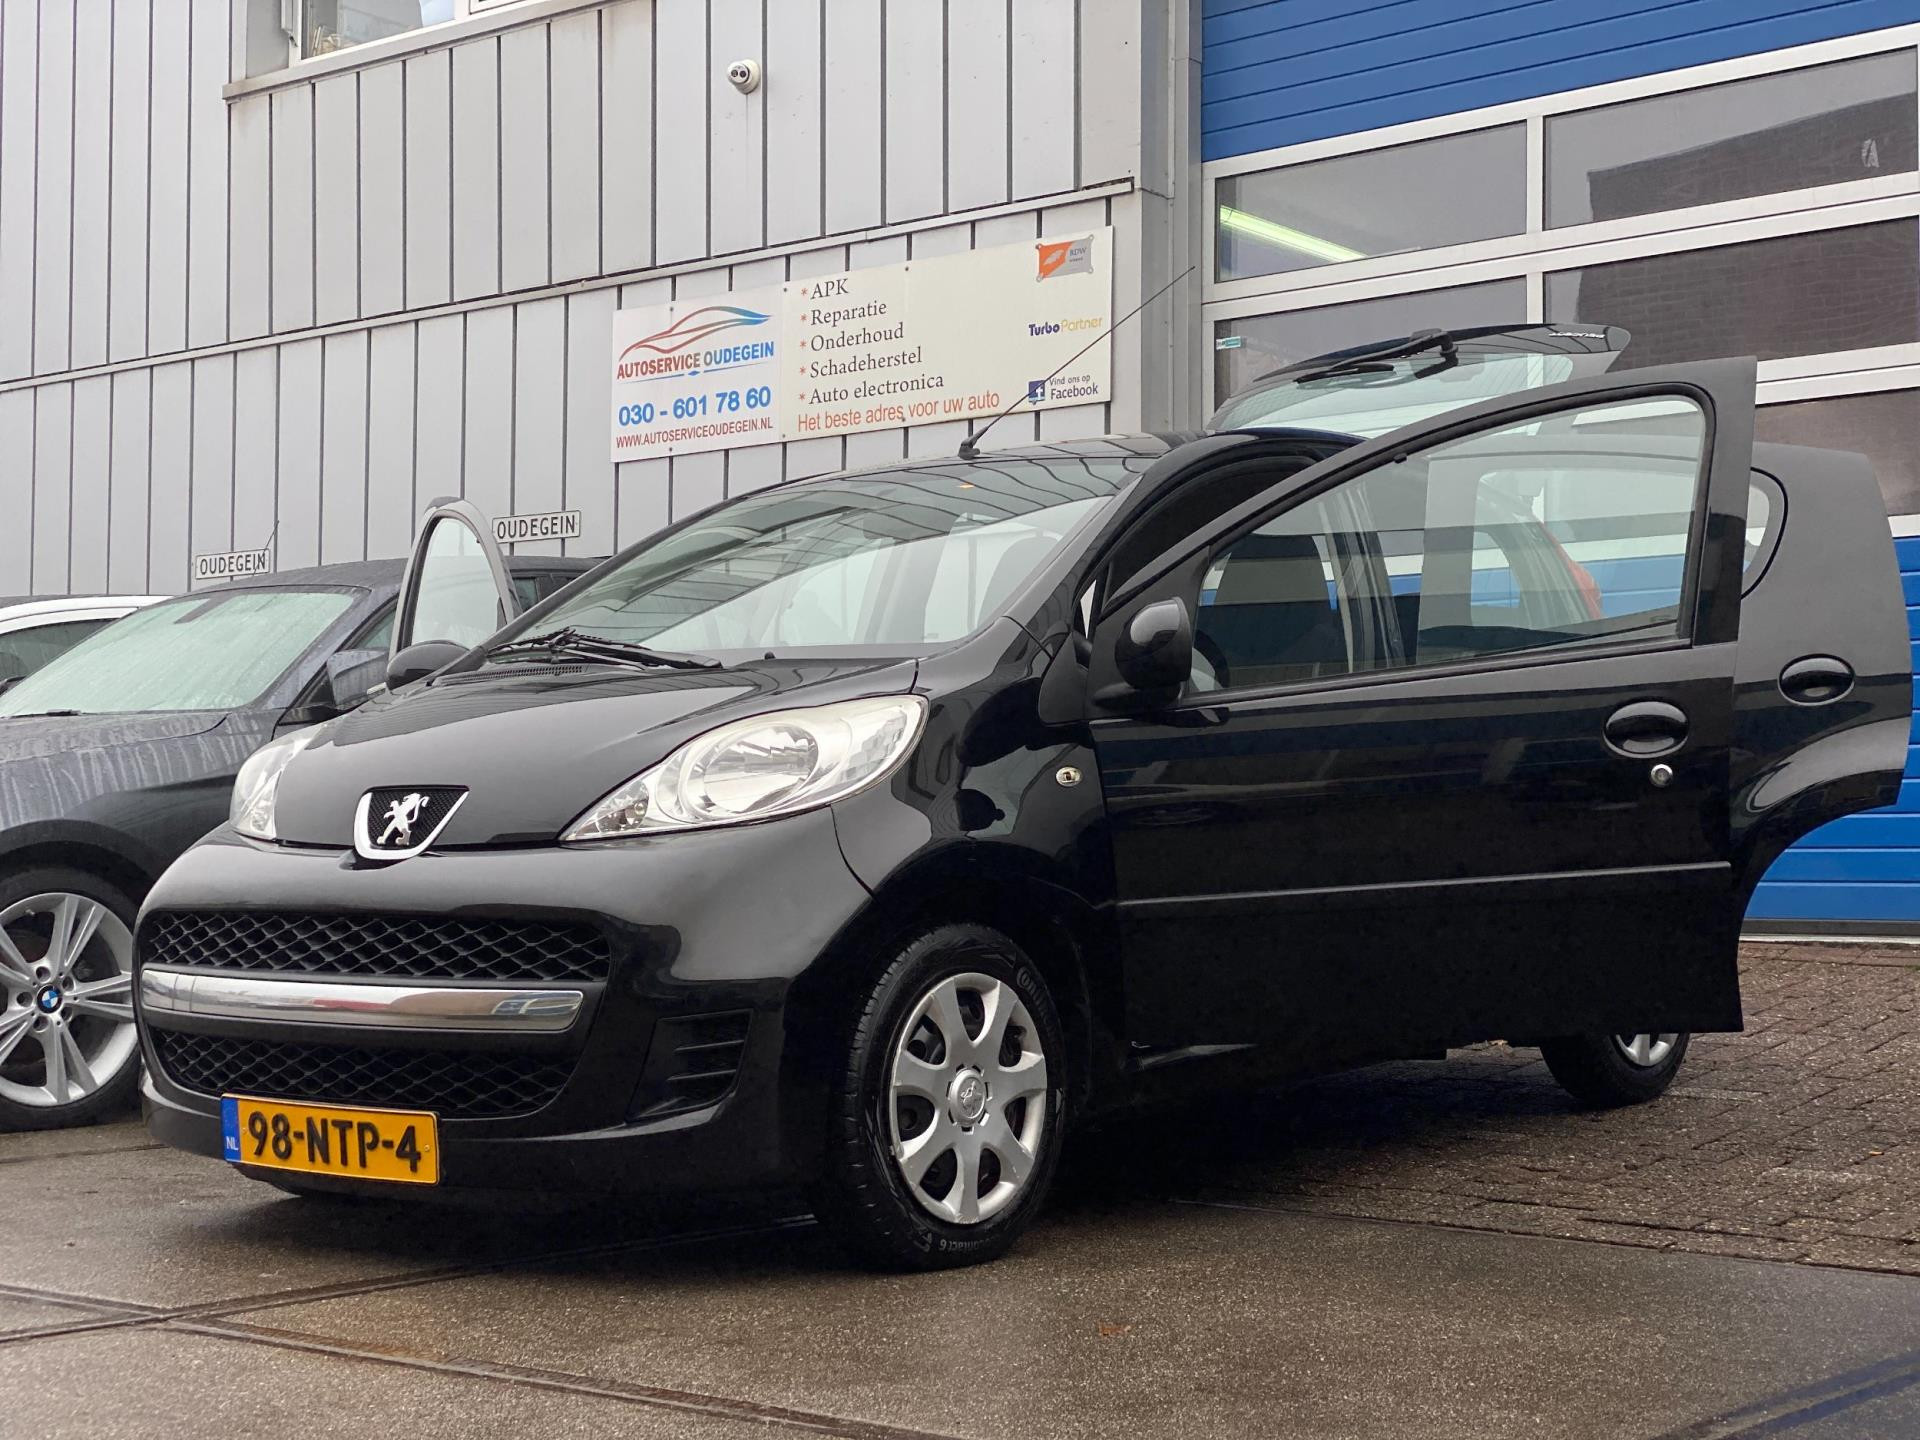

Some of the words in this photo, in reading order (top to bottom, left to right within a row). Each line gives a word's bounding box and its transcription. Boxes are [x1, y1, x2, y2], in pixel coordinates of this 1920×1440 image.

[810, 278, 849, 300] APK
[810, 300, 887, 327] Reparatie
[810, 322, 904, 352] Onderhoud
[617, 352, 700, 379] AUTOSERVICE
[704, 341, 774, 366] OUDEGEIN
[810, 346, 922, 379] Schadeherstel
[809, 385, 848, 405] Auto
[854, 374, 944, 398] electronica
[1050, 377, 1065, 385] Vind
[1082, 375, 1090, 383] op
[1051, 383, 1098, 400] Facebook
[618, 403, 654, 426] 030
[673, 395, 707, 419] 601
[715, 391, 740, 413] 78
[746, 386, 771, 409] 60
[798, 411, 821, 433] Het
[824, 407, 861, 427] beste
[865, 402, 904, 423] adres
[908, 400, 938, 418] voor
[943, 397, 964, 413] uw
[968, 390, 1000, 411] auto
[616, 417, 773, 448] WWW.AUTOSERVICEOUDEGEIN.NL
[497, 515, 575, 539] OUDEGEIN
[200, 553, 265, 575] OUDEGEIN
[226, 1136, 239, 1151] NL
[248, 1111, 422, 1173] 98-NTP-4
